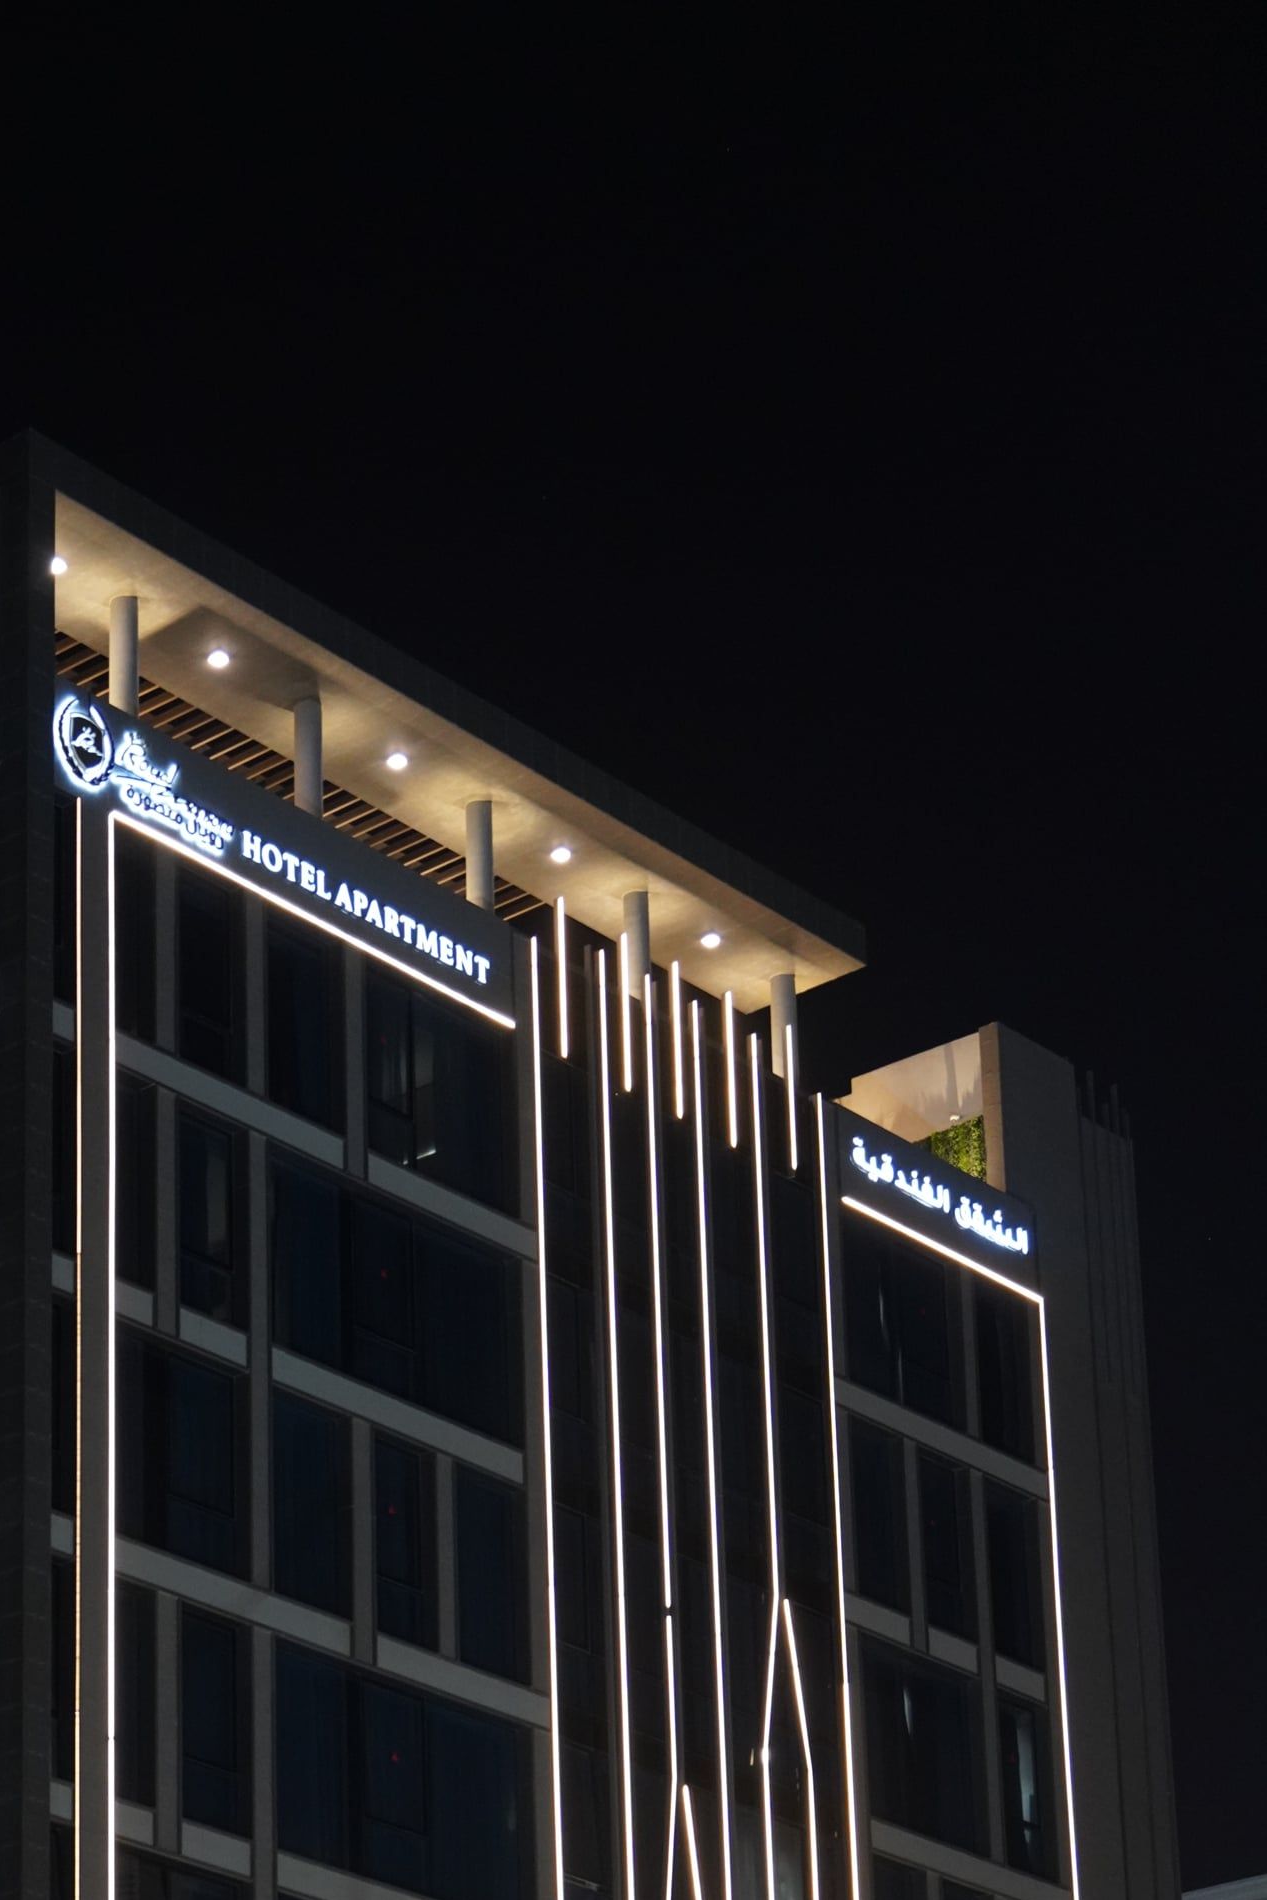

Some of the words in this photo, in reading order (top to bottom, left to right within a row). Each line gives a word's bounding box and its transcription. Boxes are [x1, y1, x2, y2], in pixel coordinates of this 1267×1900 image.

[241, 829, 332, 902] HOTEL
[334, 881, 491, 986] APARTMENT
[850, 1136, 951, 1215] الفندقية
